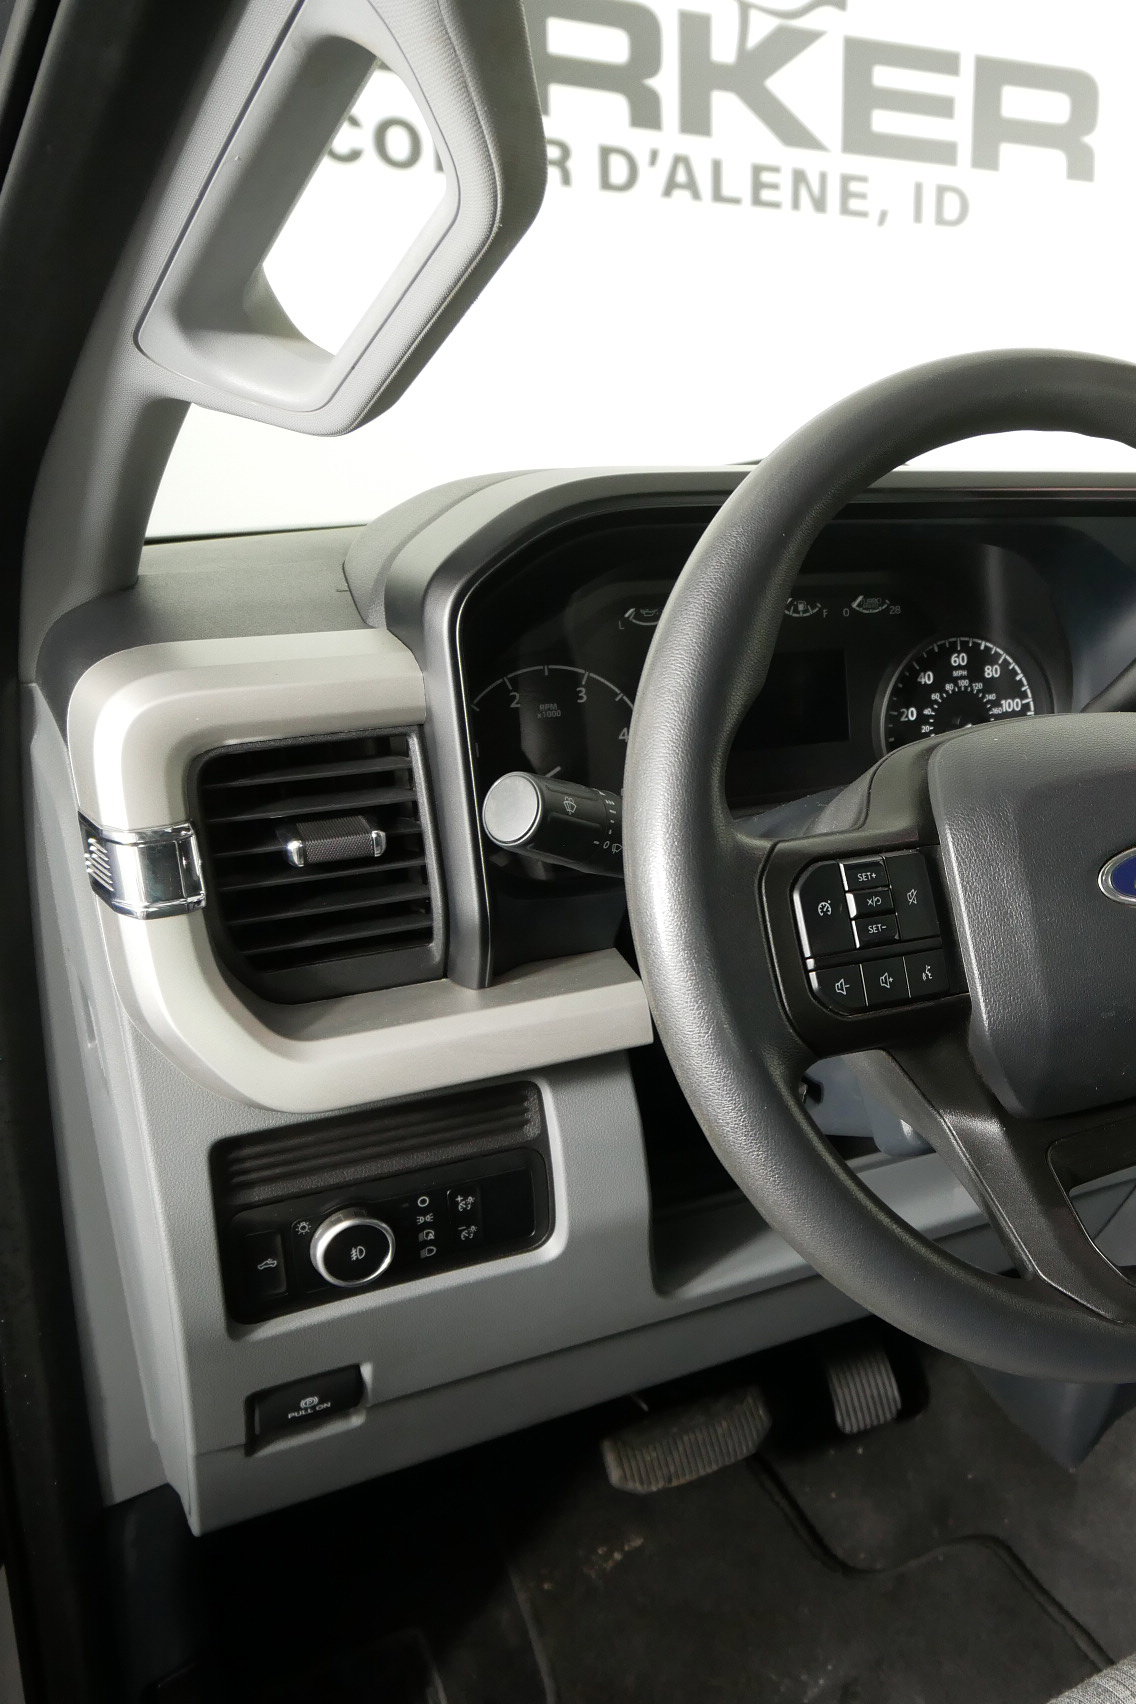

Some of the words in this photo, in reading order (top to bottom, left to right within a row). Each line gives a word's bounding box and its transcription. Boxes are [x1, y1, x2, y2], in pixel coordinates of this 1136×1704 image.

[524, 0, 1100, 183] RKER
[598, 143, 889, 227] D'ALENE,
[912, 181, 970, 228] ID
[950, 652, 968, 667] 60
[917, 671, 934, 685] 40
[984, 664, 1001, 678] 80
[945, 683, 954, 691] 80
[957, 679, 969, 687] 100
[509, 691, 521, 708] 2
[576, 687, 588, 703] 3
[539, 703, 558, 711] RPM
[1001, 699, 1022, 712] 100
[900, 707, 917, 721] 20
[618, 728, 629, 743] 4
[921, 725, 930, 733] 20
[857, 871, 877, 882] SET+
[868, 924, 887, 934] SET-
[288, 1408, 313, 1419] PULL
[316, 1401, 331, 1410] ON
